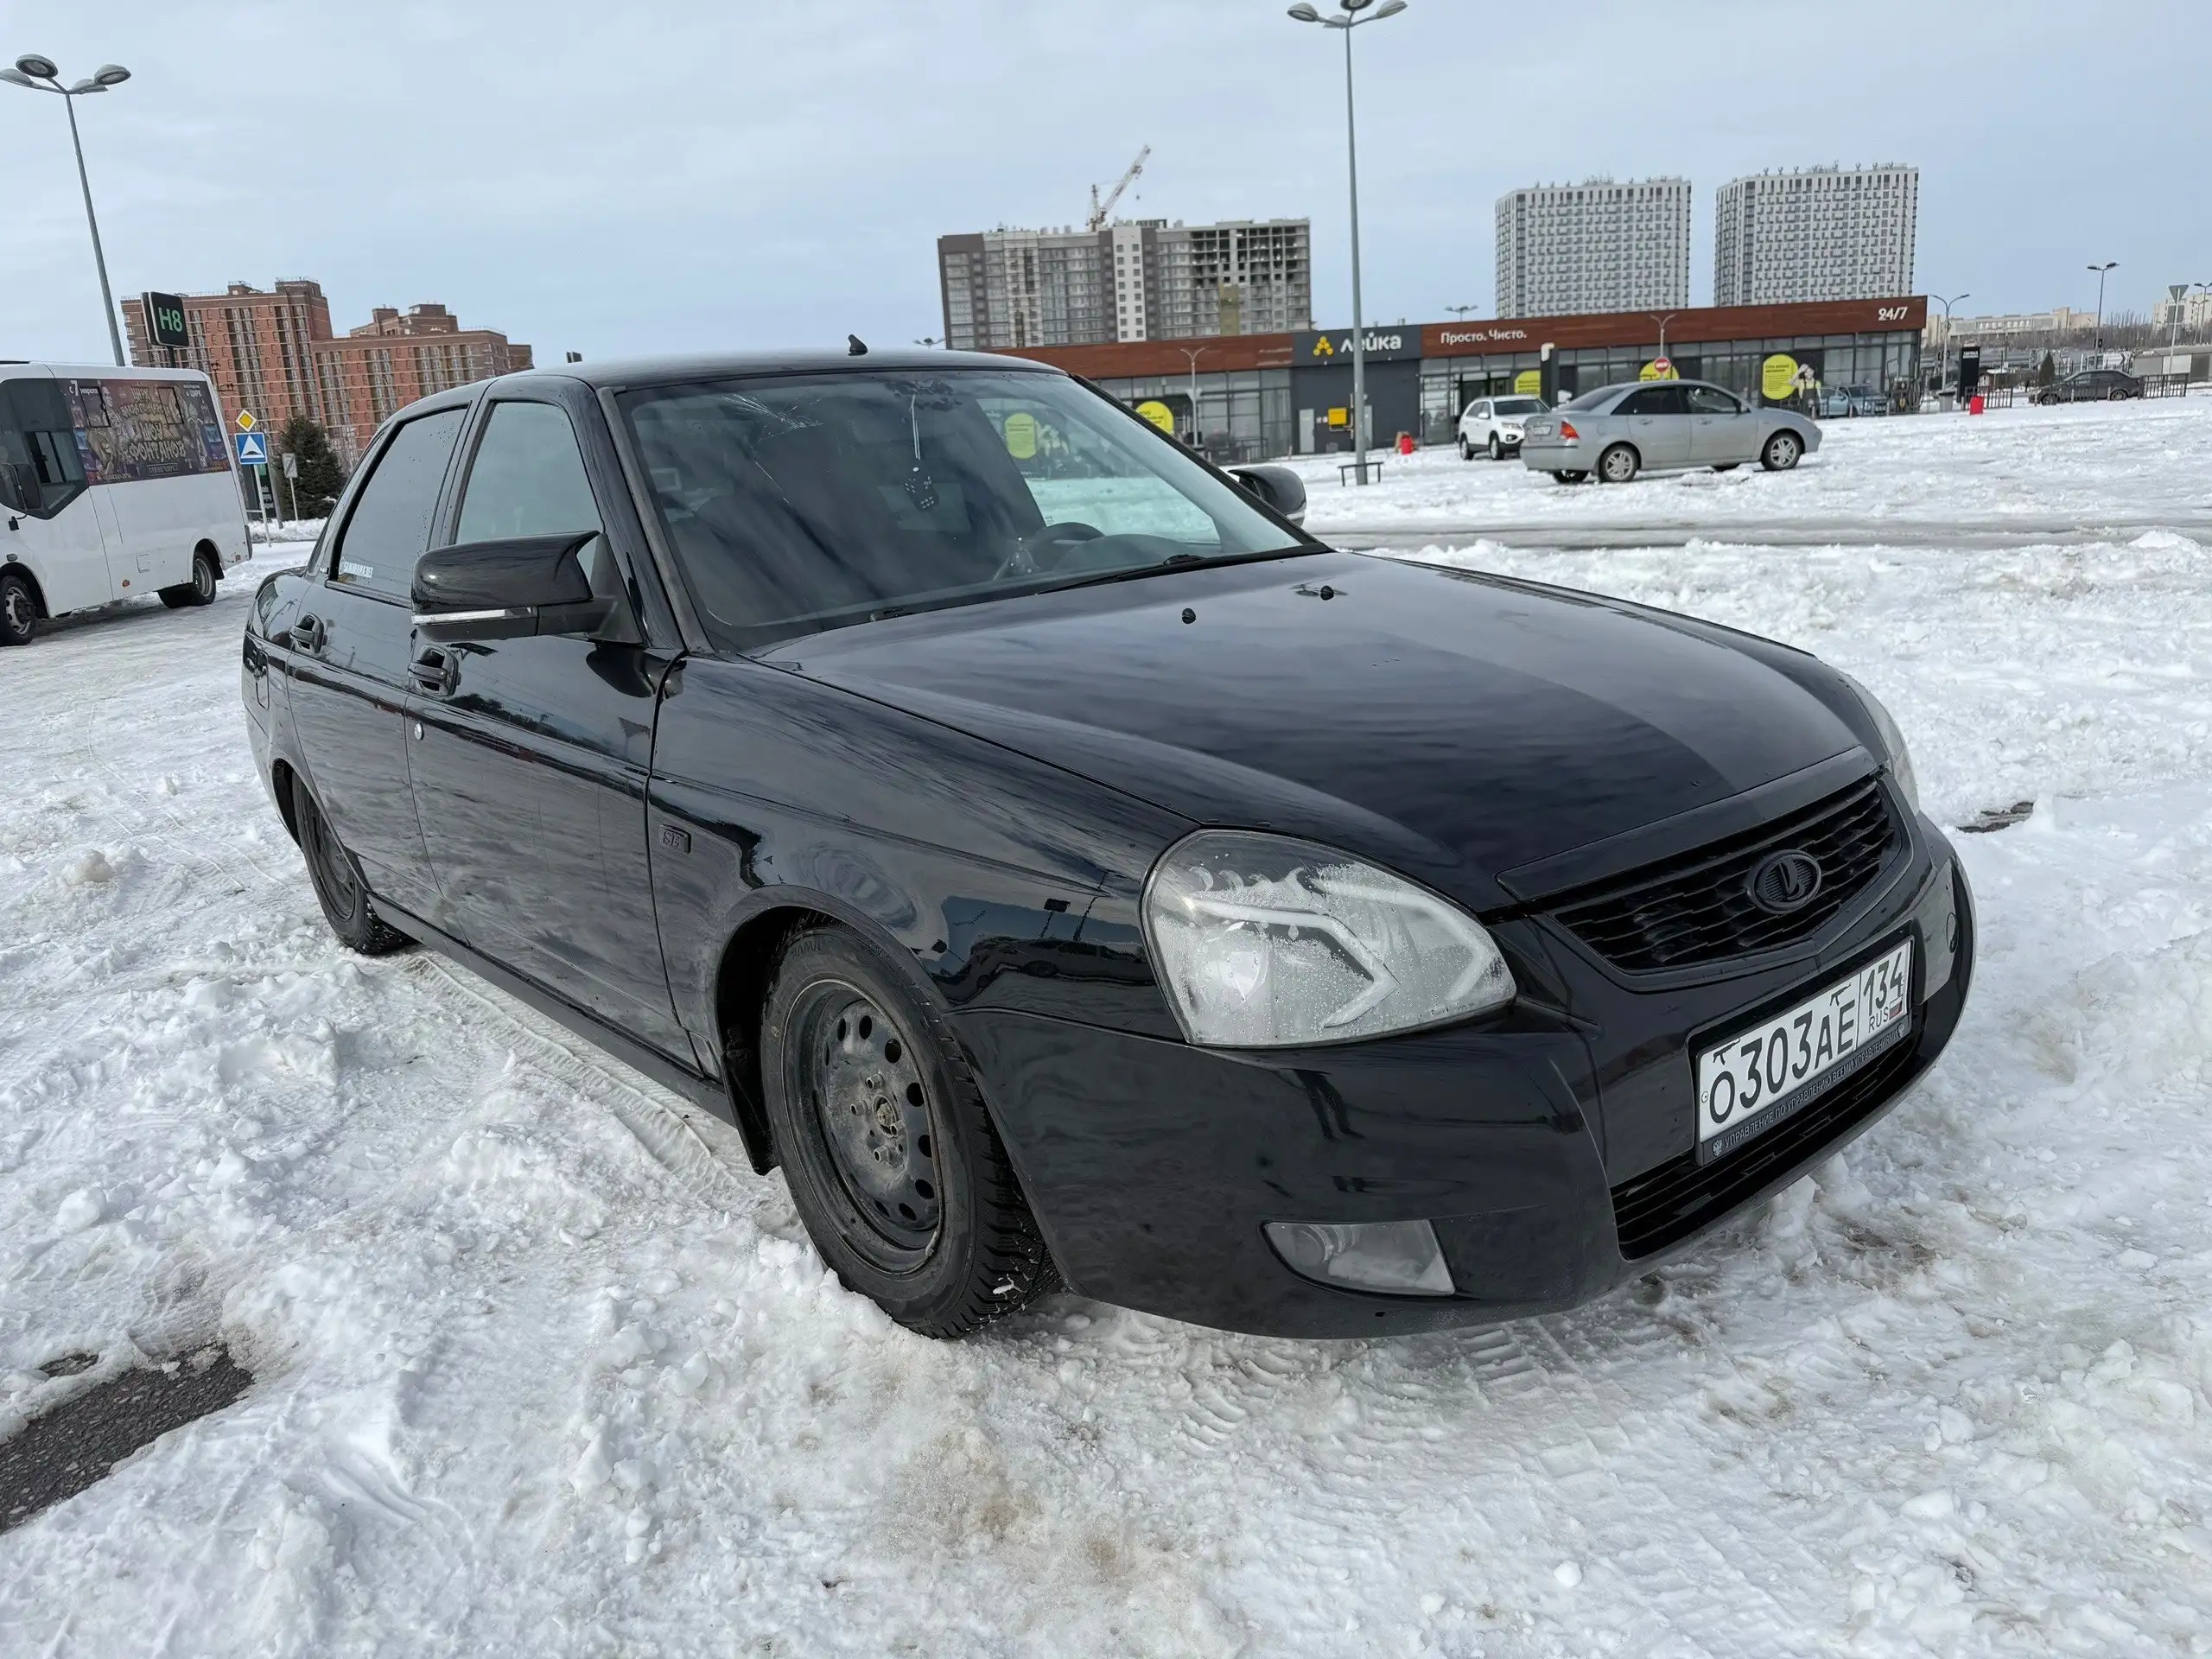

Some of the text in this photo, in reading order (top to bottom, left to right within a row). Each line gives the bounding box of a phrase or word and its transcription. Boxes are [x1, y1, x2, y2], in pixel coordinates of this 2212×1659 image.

[158, 307, 183, 332] H8
[1878, 306, 1909, 321] 24/7
[1339, 331, 1402, 353] лйка
[1440, 328, 1528, 346] Просто. Чисто.
[70, 380, 79, 397] 7
[139, 423, 163, 441] ШОУ
[129, 441, 187, 462] ФОНТАНОВ
[1868, 1006, 1890, 1033] RUS
[1709, 950, 1904, 1124] О303АЕ 134
[1724, 1111, 1774, 1148] УПРАВЛЕНИЕ
[1775, 1104, 1786, 1119] ПО
[1786, 1075, 1832, 1112] УПРАВЛЕНИЮ
[1832, 1060, 1854, 1083] ВСЕМИ
